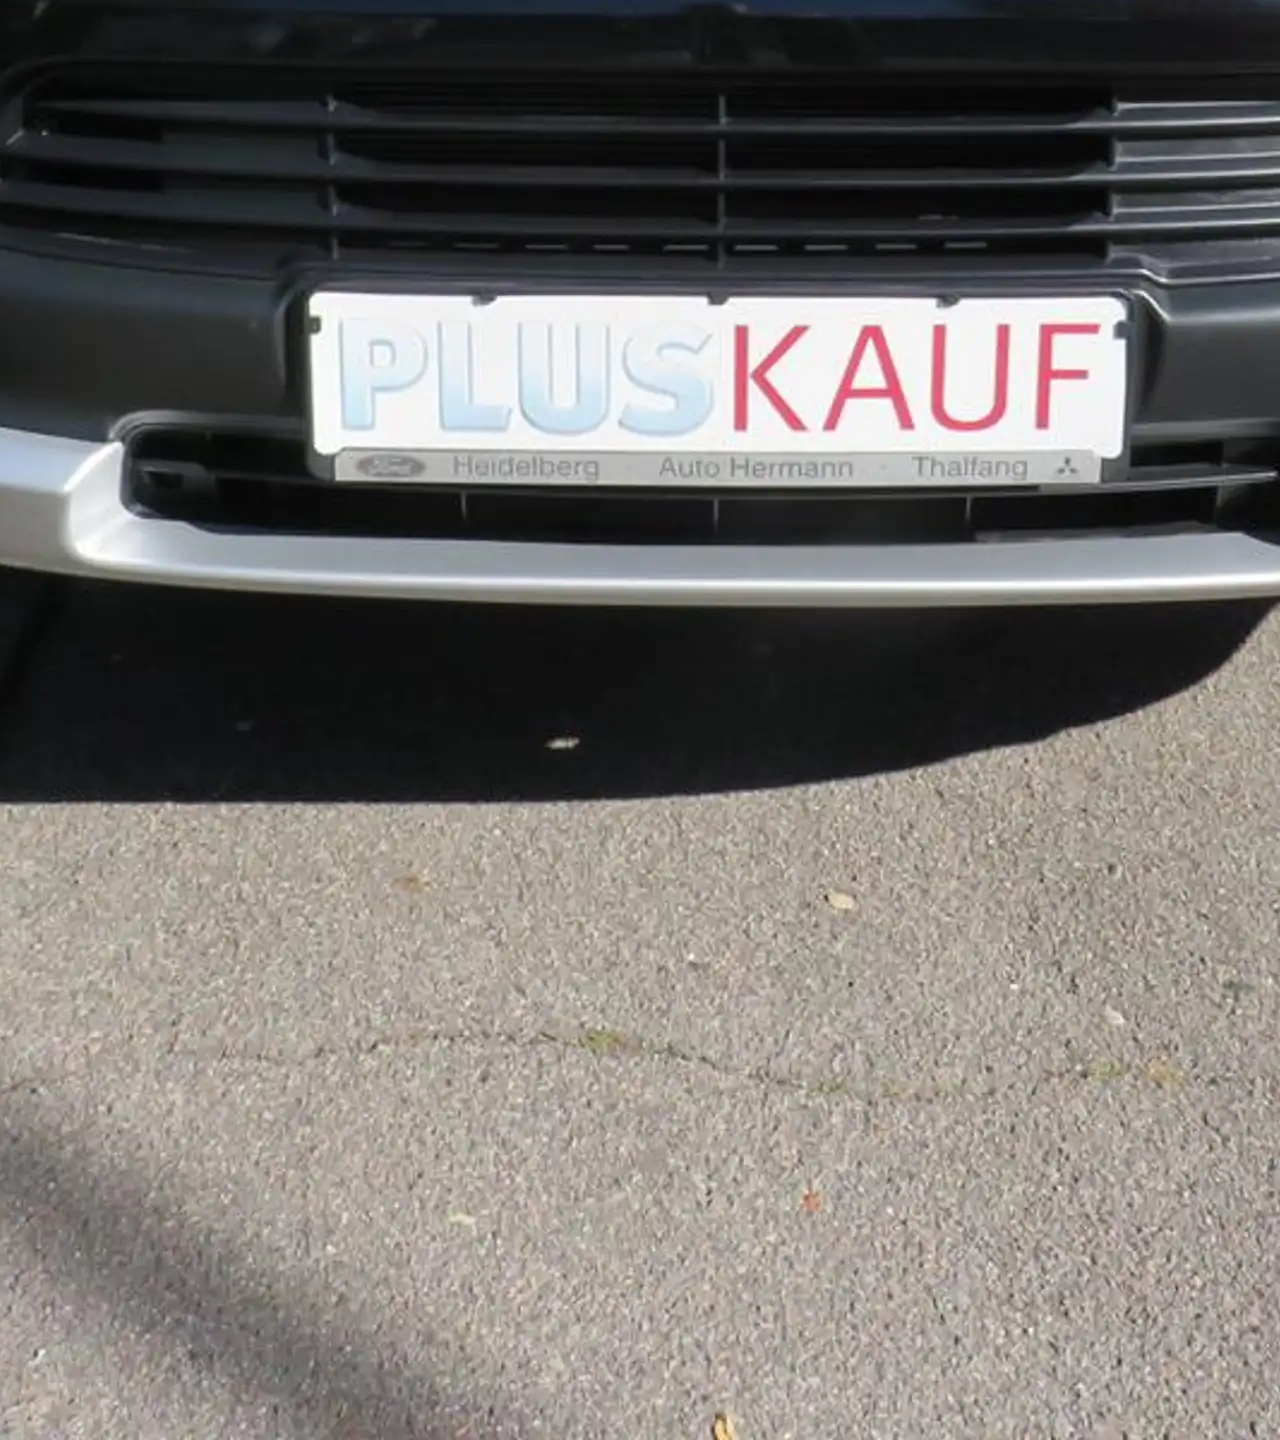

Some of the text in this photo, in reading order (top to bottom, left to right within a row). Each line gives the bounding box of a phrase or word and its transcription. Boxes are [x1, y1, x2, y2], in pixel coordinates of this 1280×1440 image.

[339, 319, 1102, 437] PLUSKAUF
[452, 456, 601, 480] Heidelberg
[658, 457, 720, 479] Auto
[730, 458, 854, 479] Hermann
[910, 456, 1028, 482] Thalfang
